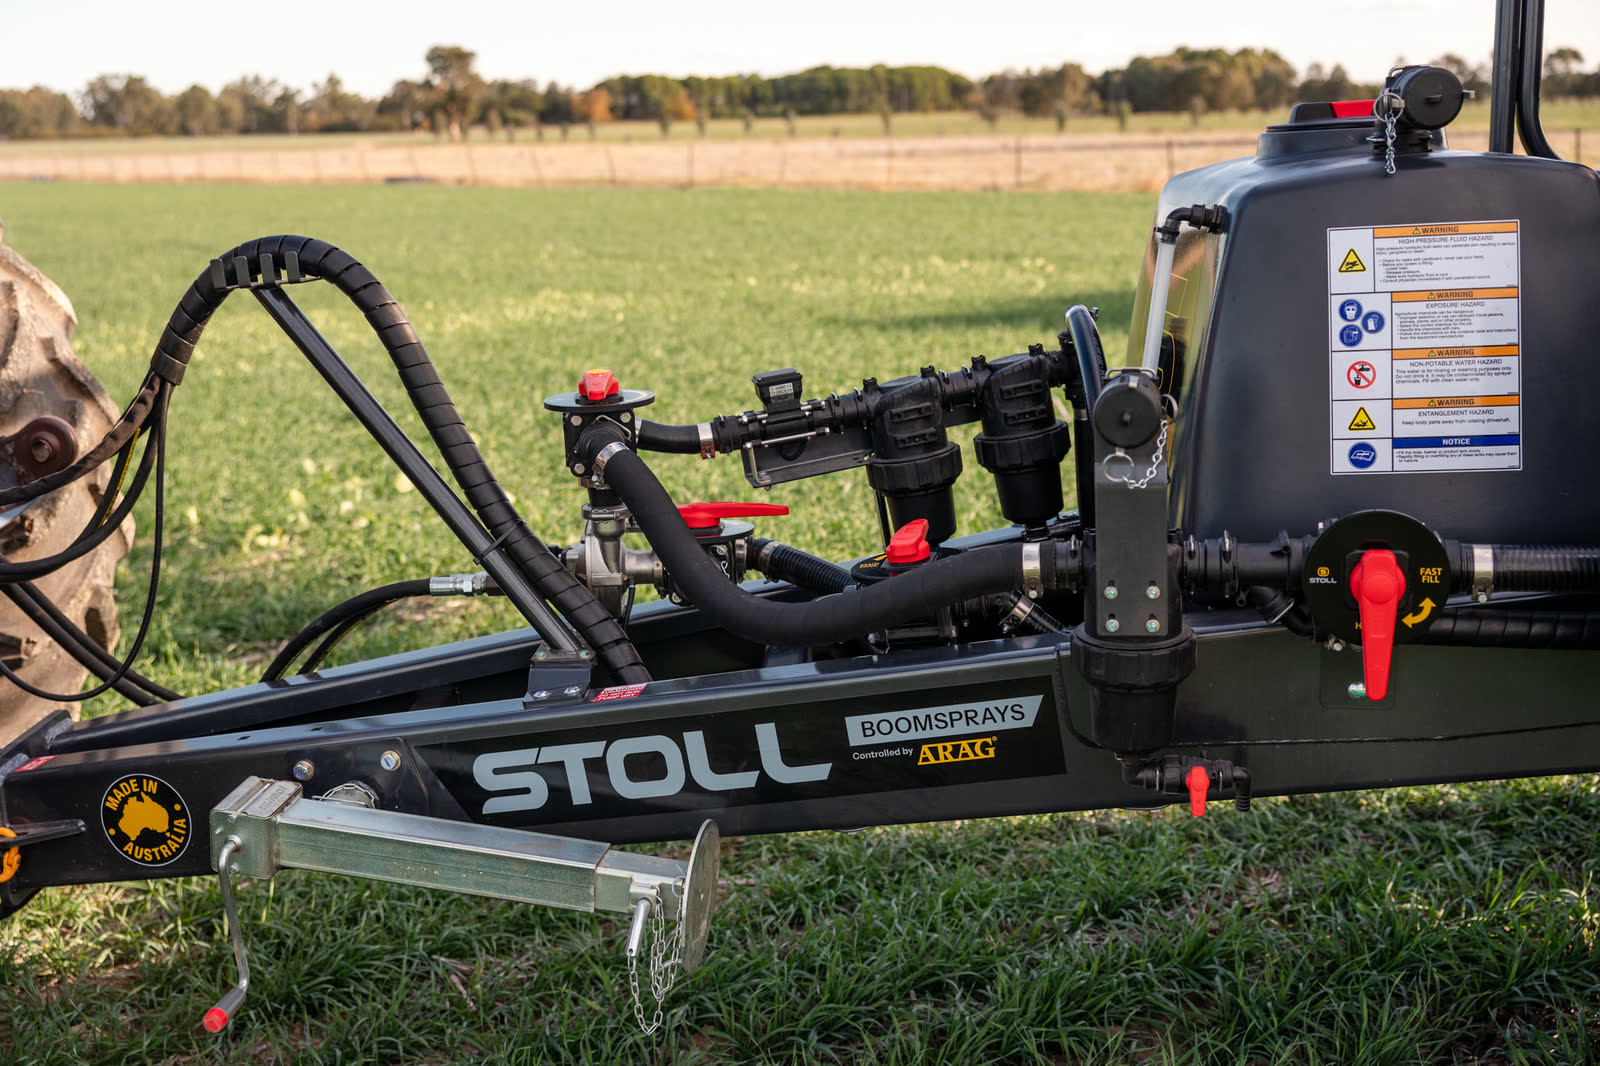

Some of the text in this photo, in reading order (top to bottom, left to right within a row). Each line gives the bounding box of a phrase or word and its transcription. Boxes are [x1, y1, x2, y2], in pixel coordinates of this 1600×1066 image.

[1437, 290, 1474, 298] WARNING
[1420, 568, 1442, 576] FAST
[861, 704, 1025, 738] BOOMSPRAYS
[473, 722, 832, 814] STOLL
[852, 748, 901, 760] Controlled
[902, 746, 914, 756] by
[105, 778, 158, 811] MADE IN
[123, 818, 186, 861] AUSTRALIA
